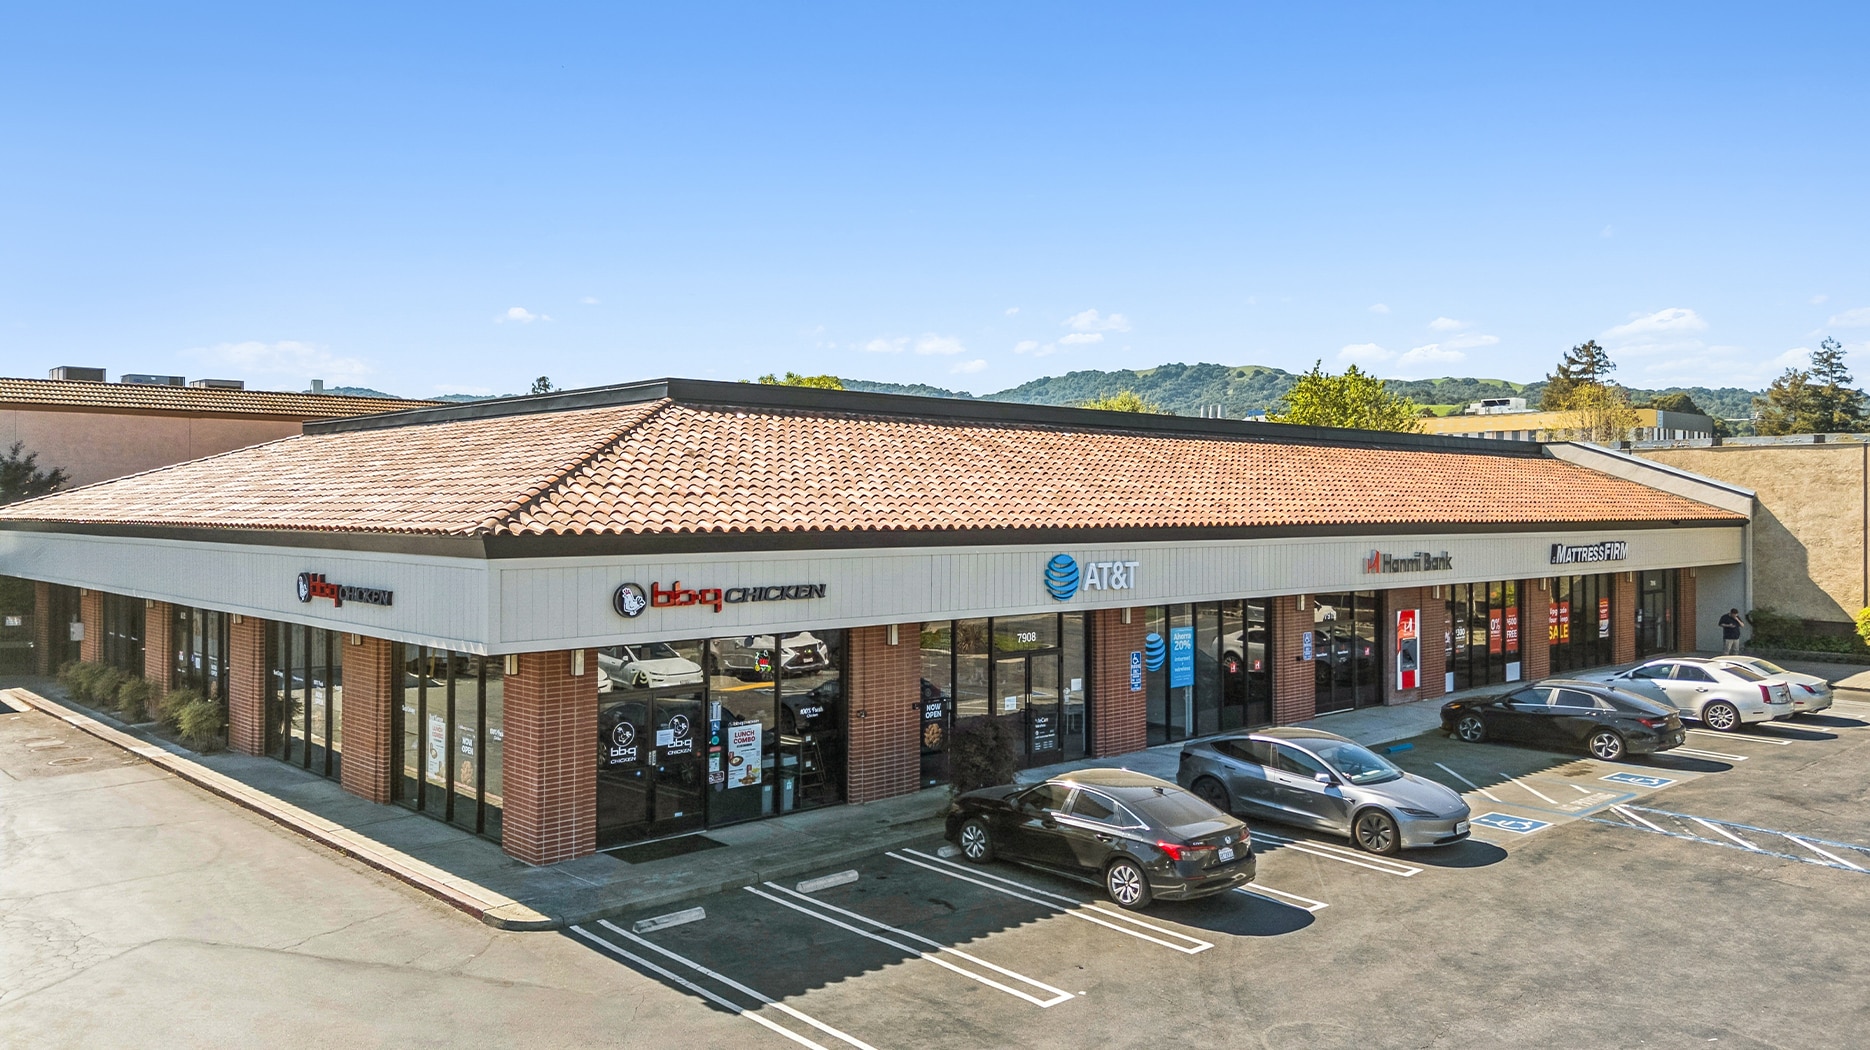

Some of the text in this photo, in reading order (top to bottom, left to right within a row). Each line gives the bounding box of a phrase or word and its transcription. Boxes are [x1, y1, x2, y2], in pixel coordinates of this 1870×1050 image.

[1382, 551, 1453, 573] Hanmi Bank
[1081, 561, 1140, 591] AT&T
[339, 586, 393, 606] CHICKEN
[724, 583, 827, 603] CHICKEN
[1549, 607, 1567, 616] Upgade
[1490, 618, 1501, 630] 0%
[1017, 631, 1037, 643] 7908
[1173, 632, 1191, 640] Ahorra
[1506, 629, 1517, 639] FREE
[1548, 624, 1569, 640] SALE
[1174, 640, 1191, 651] 20%
[926, 702, 942, 711] NOW
[925, 710, 942, 719] OPEN
[734, 730, 755, 738] LUNCH
[461, 736, 473, 747] NOW
[733, 736, 756, 744] COMBO
[461, 745, 474, 756] OPEN
